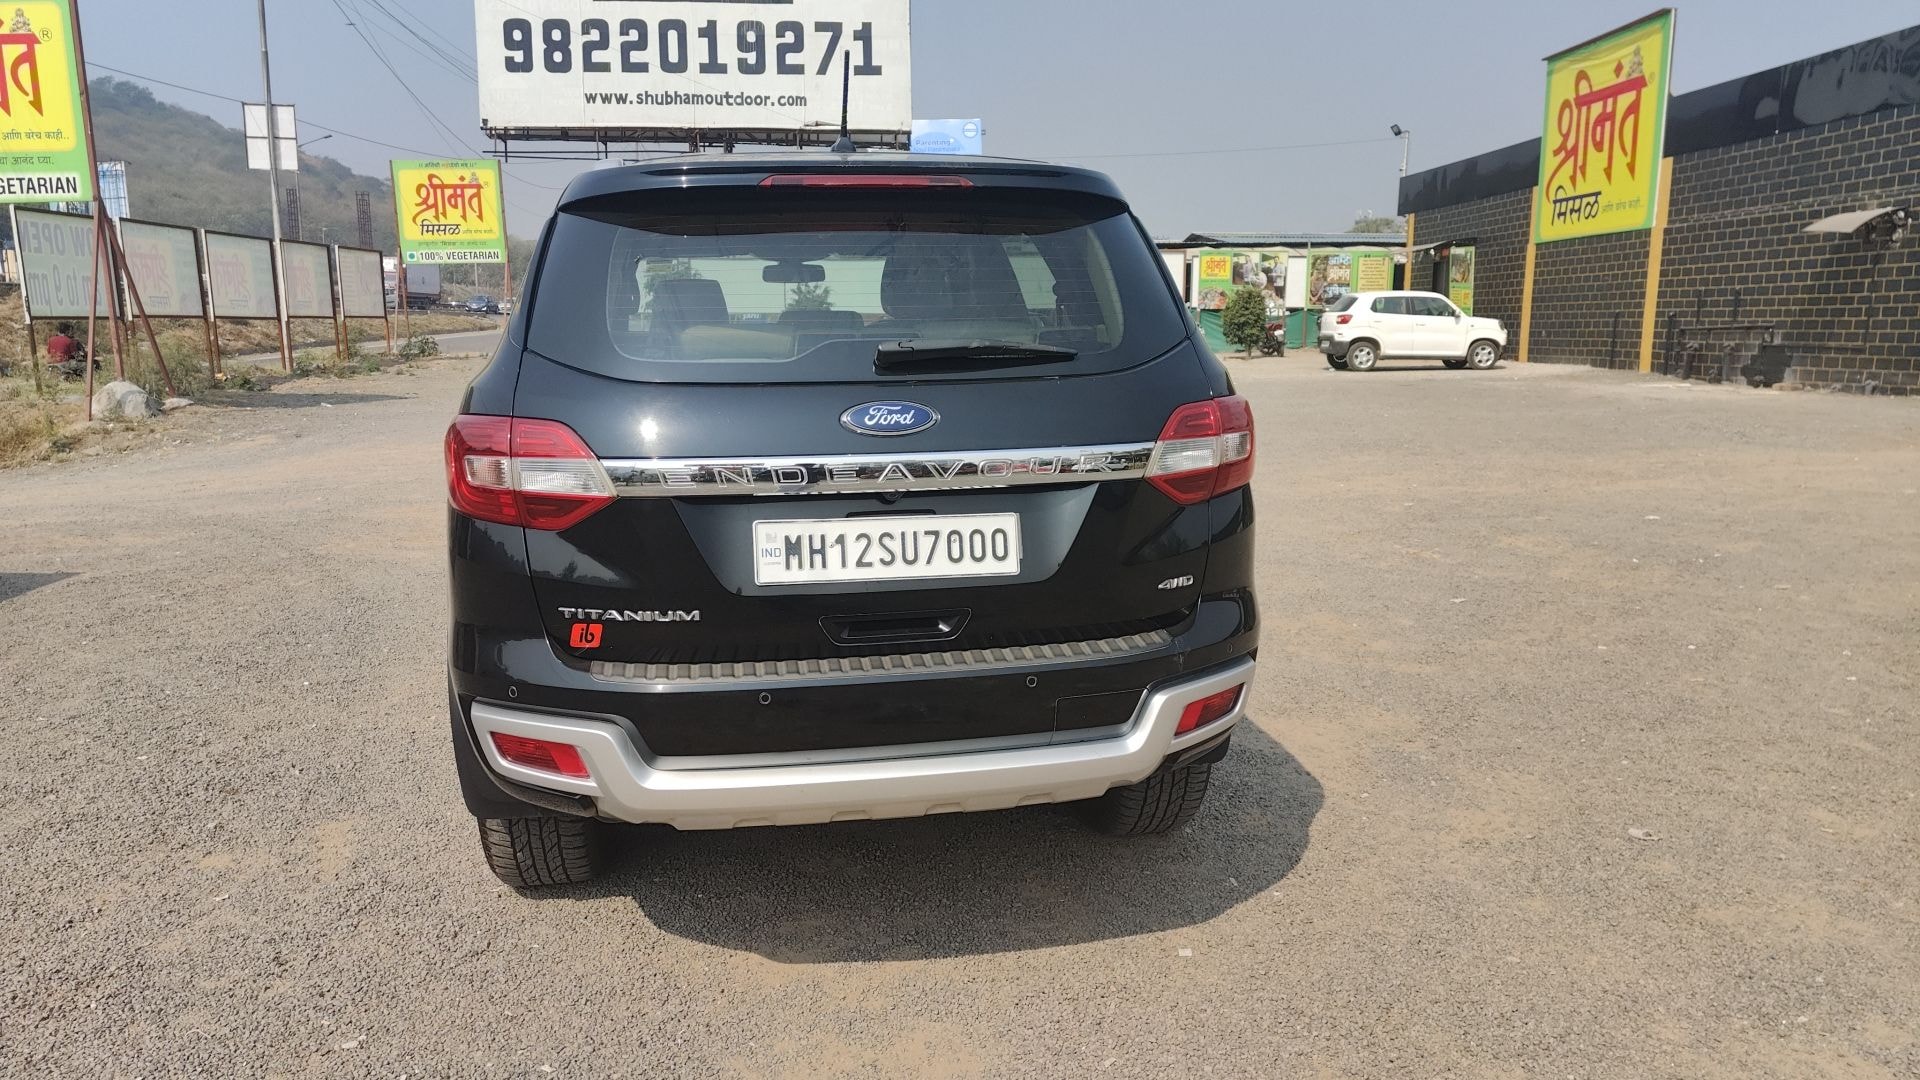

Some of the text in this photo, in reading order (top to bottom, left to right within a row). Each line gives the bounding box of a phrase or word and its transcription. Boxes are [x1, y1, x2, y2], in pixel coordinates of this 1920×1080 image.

[503, 18, 882, 75] 9822019271
[584, 90, 807, 106] www.shubhamoutdoor.com
[1545, 59, 1648, 204] श्रीमंत
[915, 138, 951, 146] Parenting
[411, 173, 484, 226] श्रीमंत
[1552, 185, 1601, 226] मिसळ
[420, 218, 461, 236] मिसळ
[420, 250, 499, 260] 100% VEGETARIAN
[864, 405, 916, 426] Ford
[658, 449, 1117, 490] ENDEAVOUR
[761, 547, 782, 558] IND
[784, 527, 1009, 571] MH12SU7000
[557, 606, 701, 622] TITANIUM
[578, 623, 595, 643] ib
